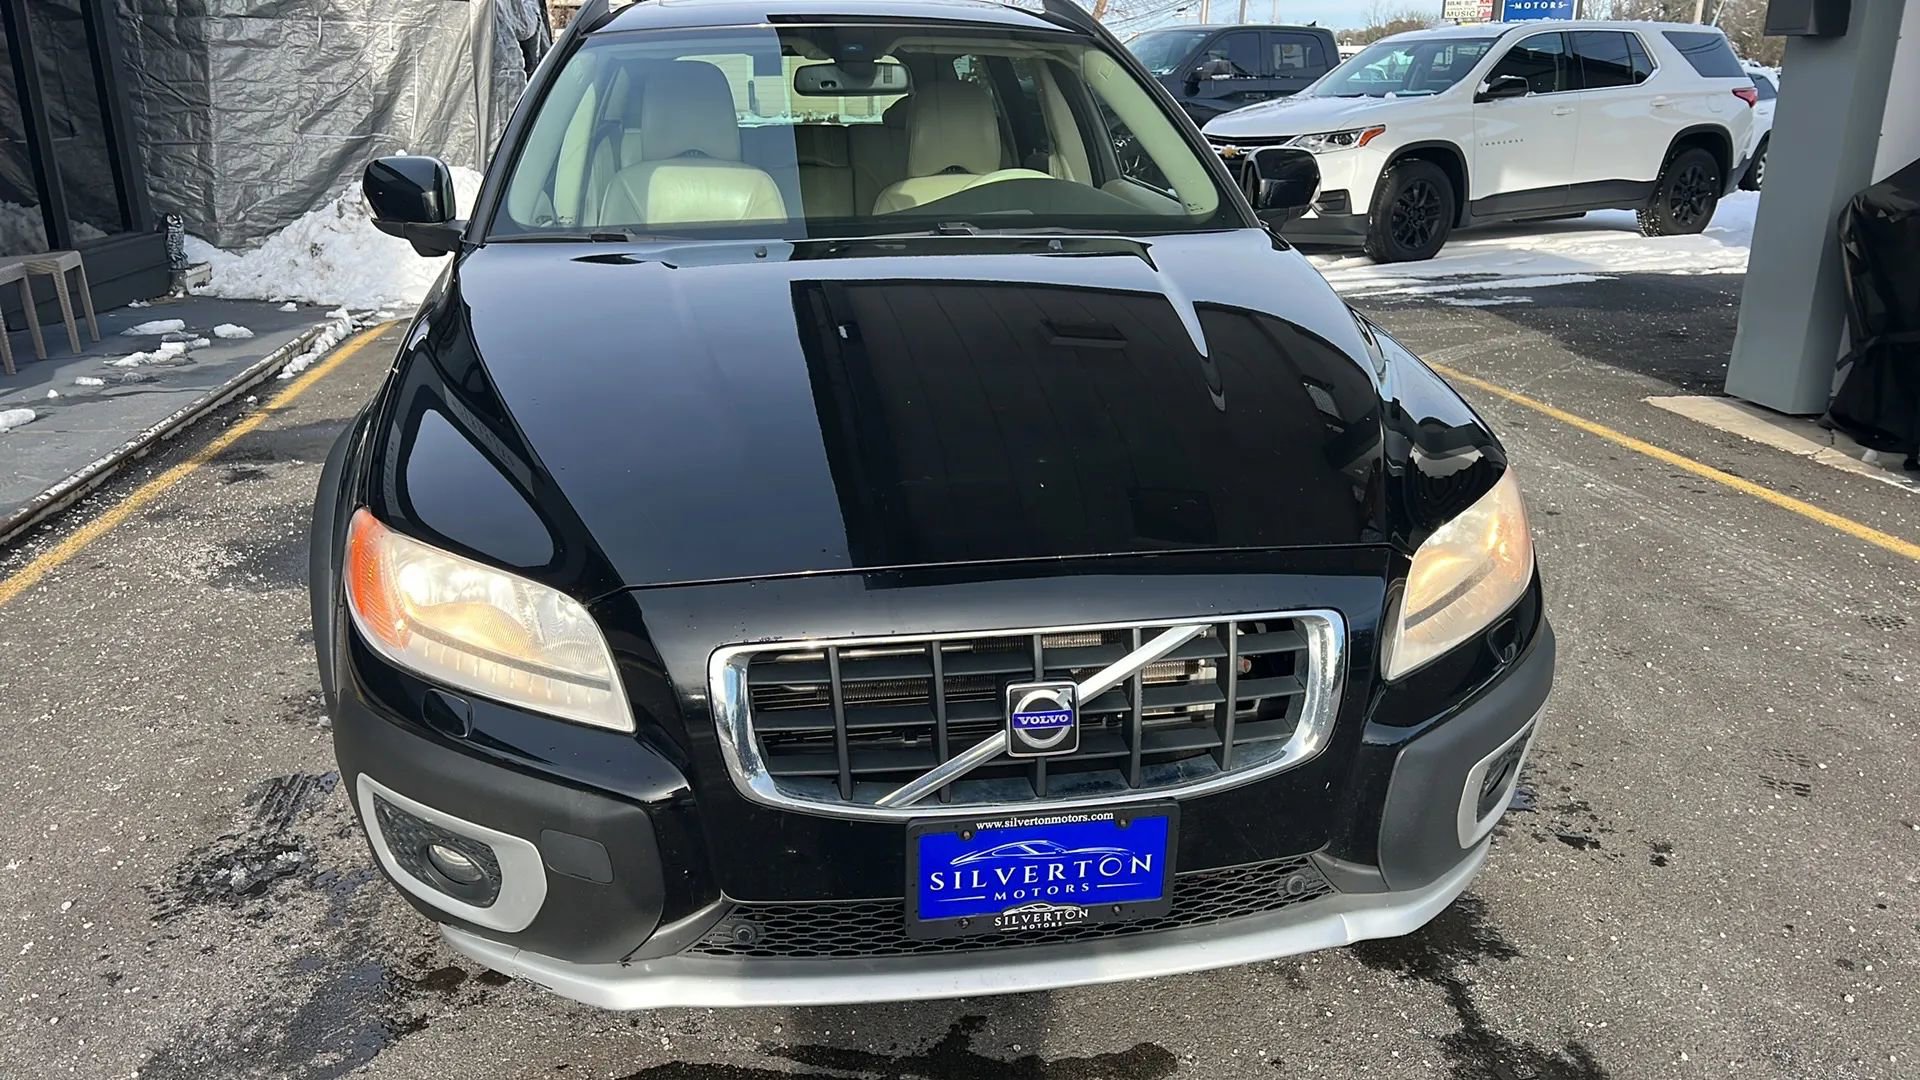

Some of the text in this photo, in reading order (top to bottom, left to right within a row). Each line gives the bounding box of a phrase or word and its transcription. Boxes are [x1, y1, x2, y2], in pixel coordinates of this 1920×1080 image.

[1514, 1, 1564, 9] MOTORS
[1017, 714, 1069, 725] VOLVO
[975, 812, 1114, 830] www.silvertonmotors.com
[930, 853, 1152, 891] SILVERTON
[994, 882, 1090, 901] MOTORS
[994, 908, 1089, 927] SILVERTON
[1021, 921, 1063, 931] MOTORS
